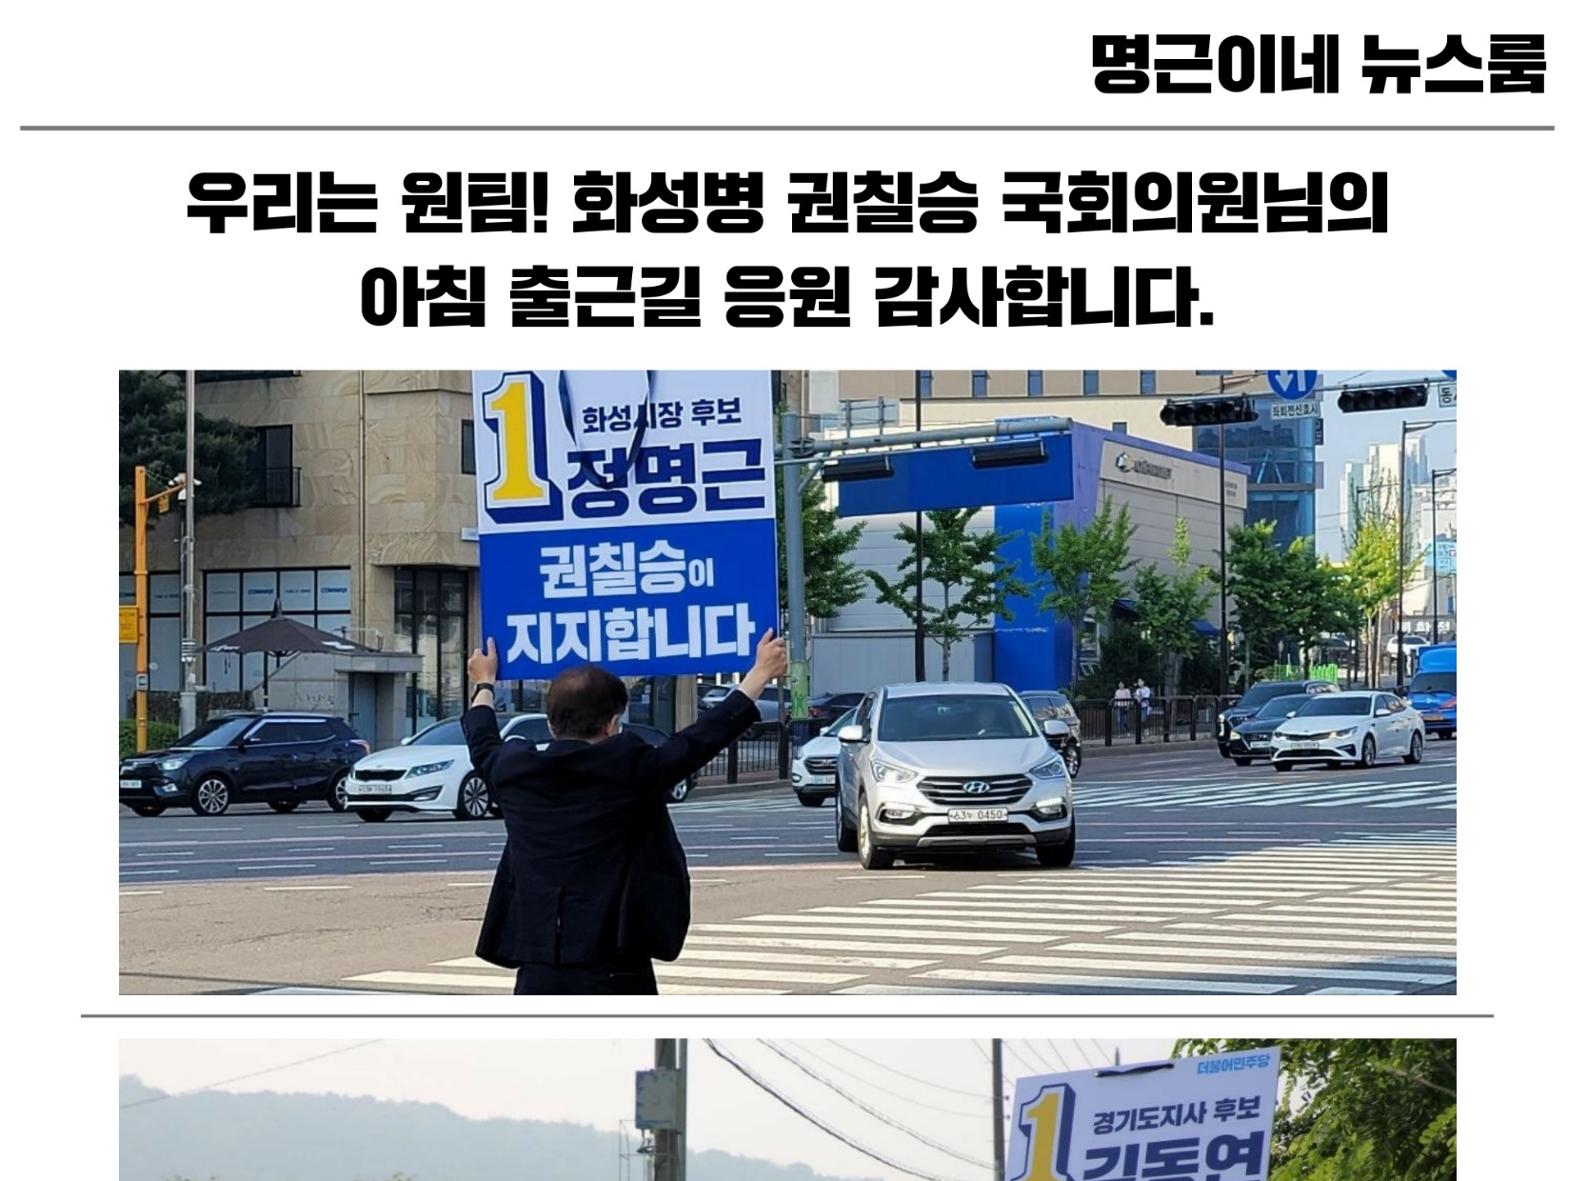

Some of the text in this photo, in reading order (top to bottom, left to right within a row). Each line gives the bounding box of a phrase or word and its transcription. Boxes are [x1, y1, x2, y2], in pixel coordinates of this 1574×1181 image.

[582, 397, 742, 434] 화성시장 후보
[483, 371, 564, 524] 1
[567, 438, 765, 519] 정명근
[540, 540, 715, 599] 권칠승이
[507, 602, 756, 664] 지지합니다
[1197, 1054, 1271, 1074] 더불어민주당
[1093, 1096, 1261, 1135] 경기도지사 후보
